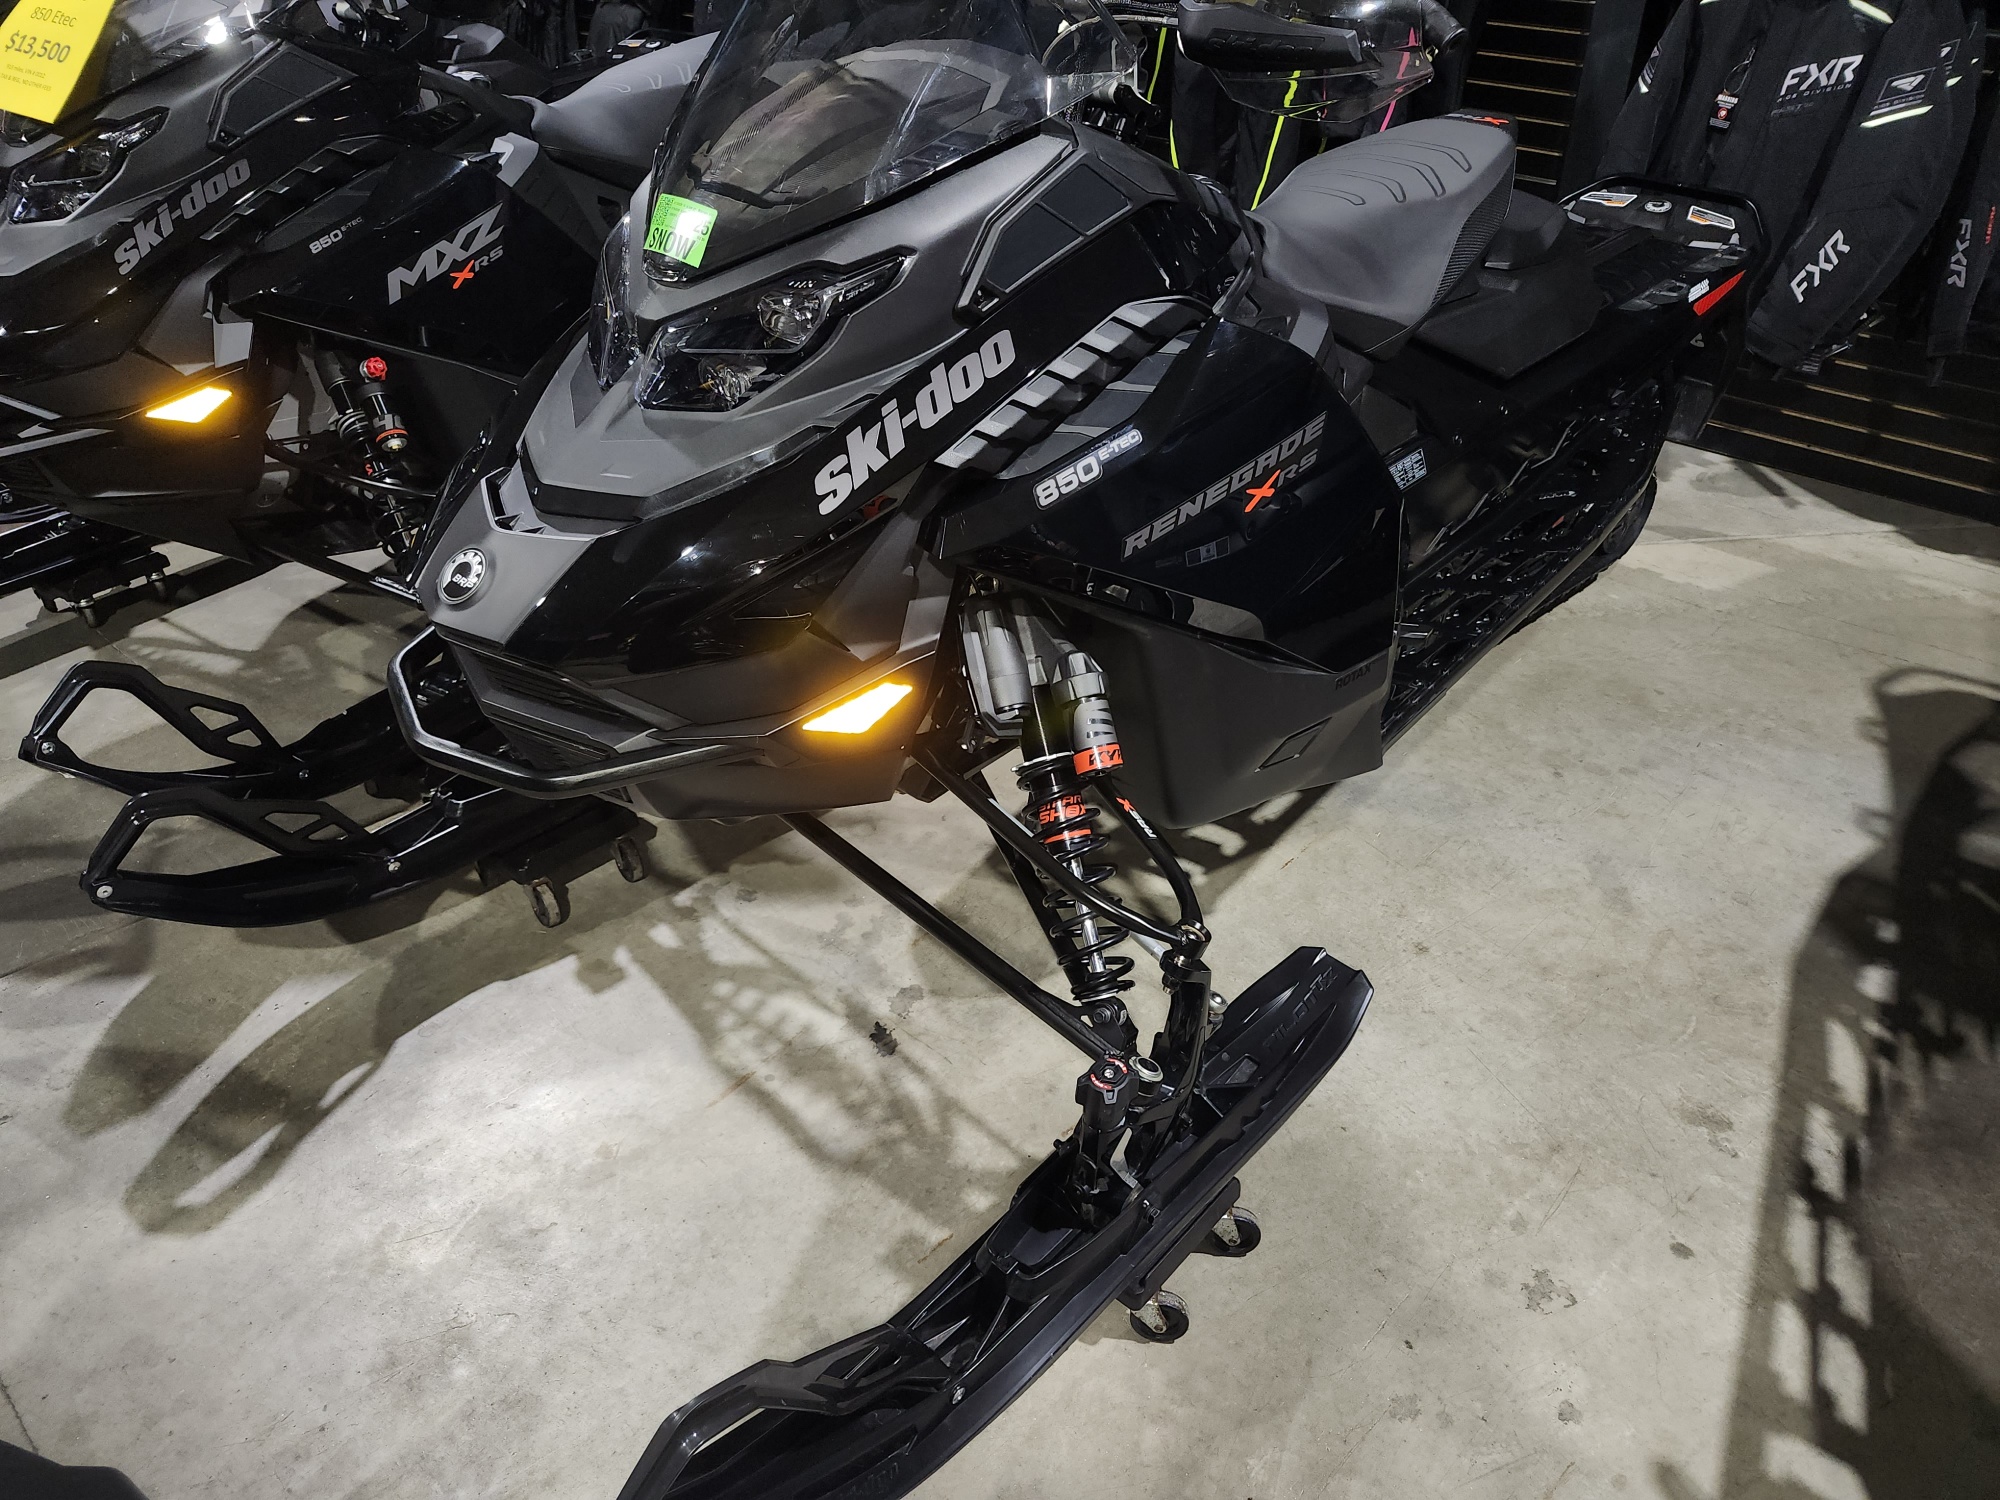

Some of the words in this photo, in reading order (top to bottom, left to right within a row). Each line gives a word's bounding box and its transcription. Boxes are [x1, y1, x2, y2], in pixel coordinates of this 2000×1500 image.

[31, 7, 53, 22] 850
[51, 10, 77, 28] Etec
[5, 30, 71, 63] $13,500
[1780, 54, 1864, 96] FXR
[309, 229, 343, 254] 850
[341, 216, 364, 232] E-TEC
[387, 202, 504, 305] MXZ
[649, 226, 696, 260] SNOW
[1947, 218, 1972, 288] FXR
[1790, 229, 1850, 303] FXR
[1035, 455, 1101, 508] 850
[1098, 430, 1140, 461] E-TEC
[1123, 414, 1327, 559] RENEGADE
[452, 573, 475, 588] BRP
[1335, 662, 1371, 690] ROTAX
